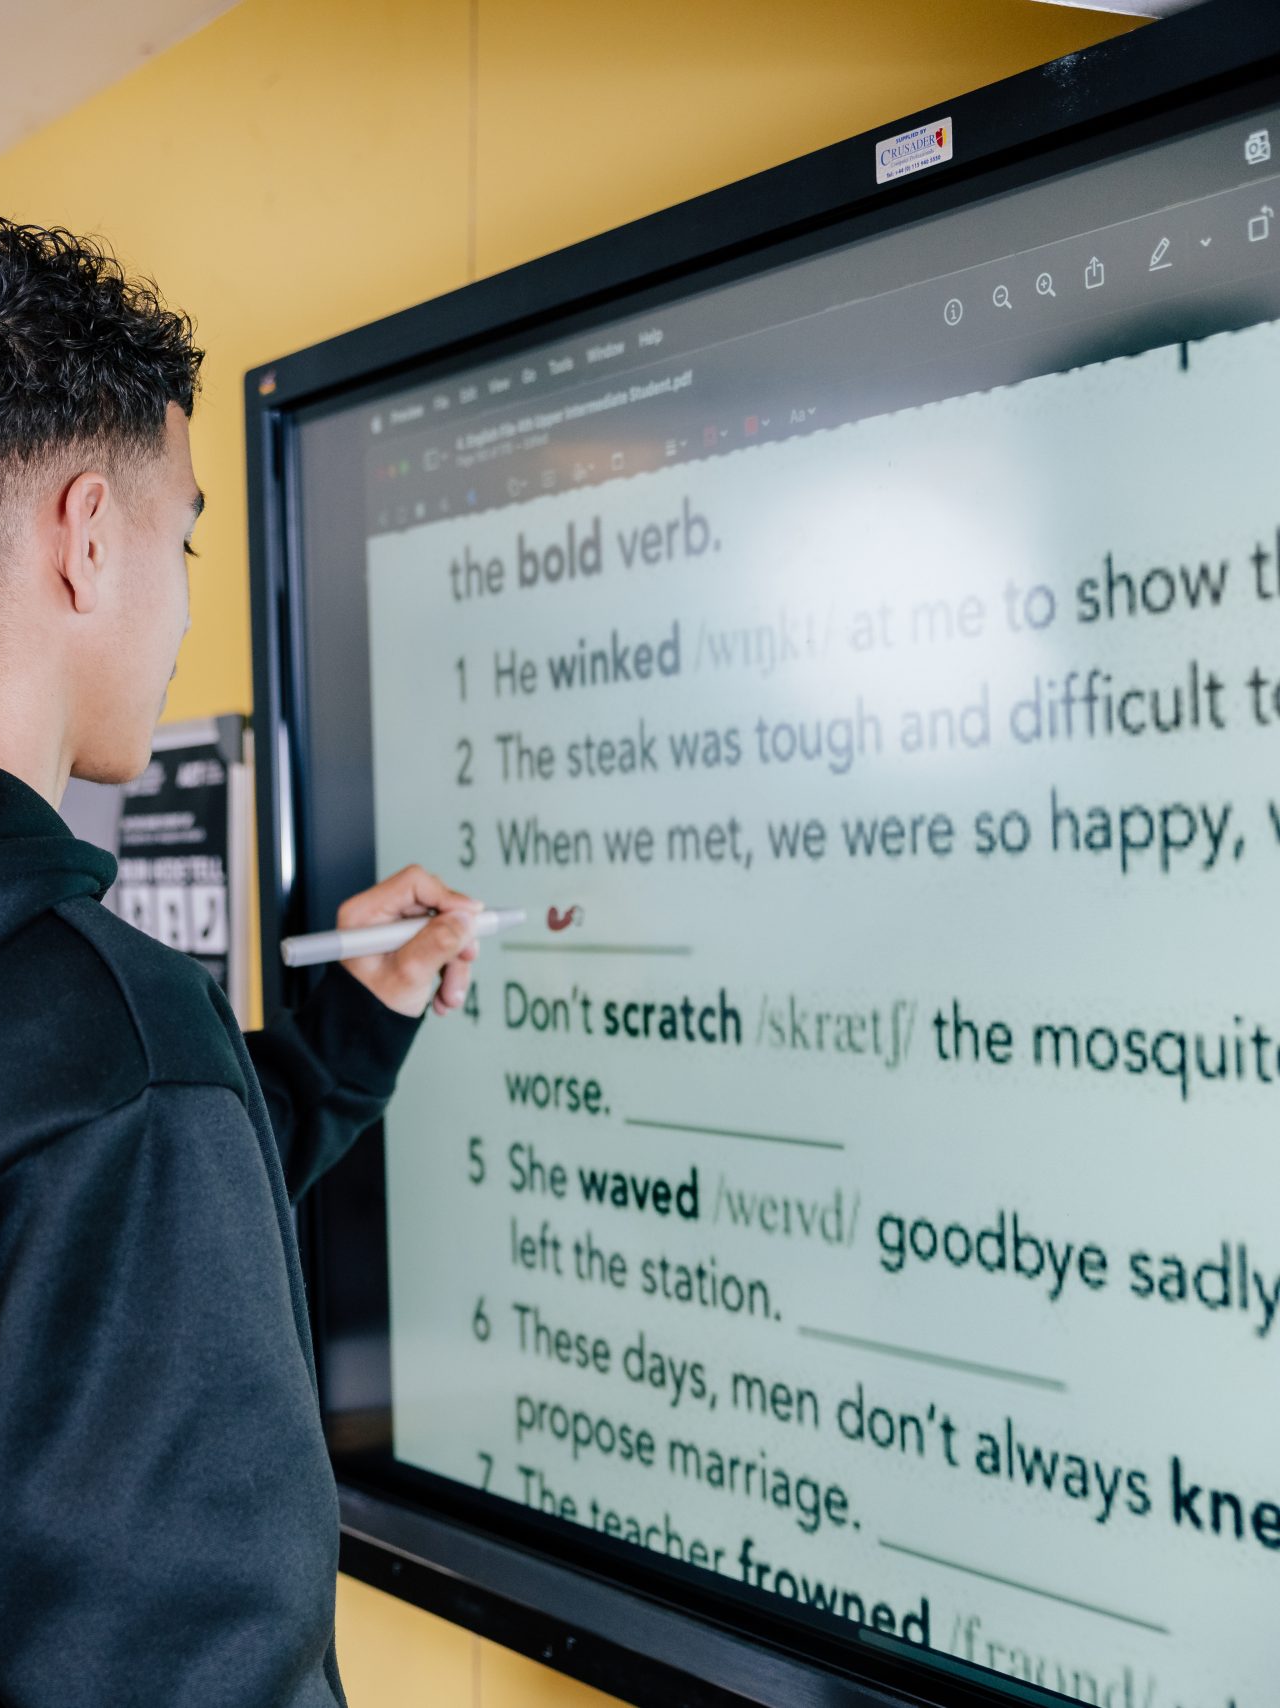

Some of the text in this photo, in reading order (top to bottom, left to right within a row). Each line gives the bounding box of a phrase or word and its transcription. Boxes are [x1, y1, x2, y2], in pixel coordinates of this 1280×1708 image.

[881, 134, 936, 166] CRUSADER
[895, 127, 927, 144] SUPPLIED BY
[450, 496, 722, 602] the bold verb.
[455, 656, 468, 701] 1
[494, 649, 538, 699] He
[548, 619, 682, 691] winked
[850, 602, 896, 652] at
[911, 594, 985, 645] me
[1004, 577, 1057, 632] to
[1076, 550, 1229, 624] show
[1249, 524, 1280, 601] t
[456, 657, 1280, 786] 2 The steak was tough and difficult t
[457, 818, 476, 871] 3
[496, 813, 593, 868] When
[604, 823, 654, 863] we
[667, 815, 753, 871] met,
[768, 816, 827, 862] we
[841, 811, 955, 858] were
[974, 807, 1032, 857] so
[1050, 783, 1246, 876] happy,
[463, 978, 480, 1028] 4
[503, 979, 594, 1035] Don't
[604, 987, 742, 1046] scratch
[932, 996, 1014, 1065] the
[1032, 1013, 1280, 1102] mosquit
[505, 1070, 611, 1117] worse.
[468, 1136, 486, 1186] 5
[509, 1142, 568, 1199] She
[579, 1164, 700, 1221] waved
[877, 1208, 1110, 1304] goodbye
[1129, 1239, 1280, 1340] sadly
[511, 1216, 782, 1322] left the station.
[472, 1296, 491, 1344] 6
[512, 1302, 612, 1375] These
[623, 1330, 718, 1411] days,
[731, 1370, 820, 1431] men
[837, 1381, 960, 1468] don't
[975, 1415, 1153, 1525] always
[516, 1394, 861, 1534] propose marriage.
[477, 1450, 494, 1492] 7
[517, 1465, 577, 1518] The
[589, 1496, 726, 1574] teacher
[738, 1538, 931, 1650] frowned
